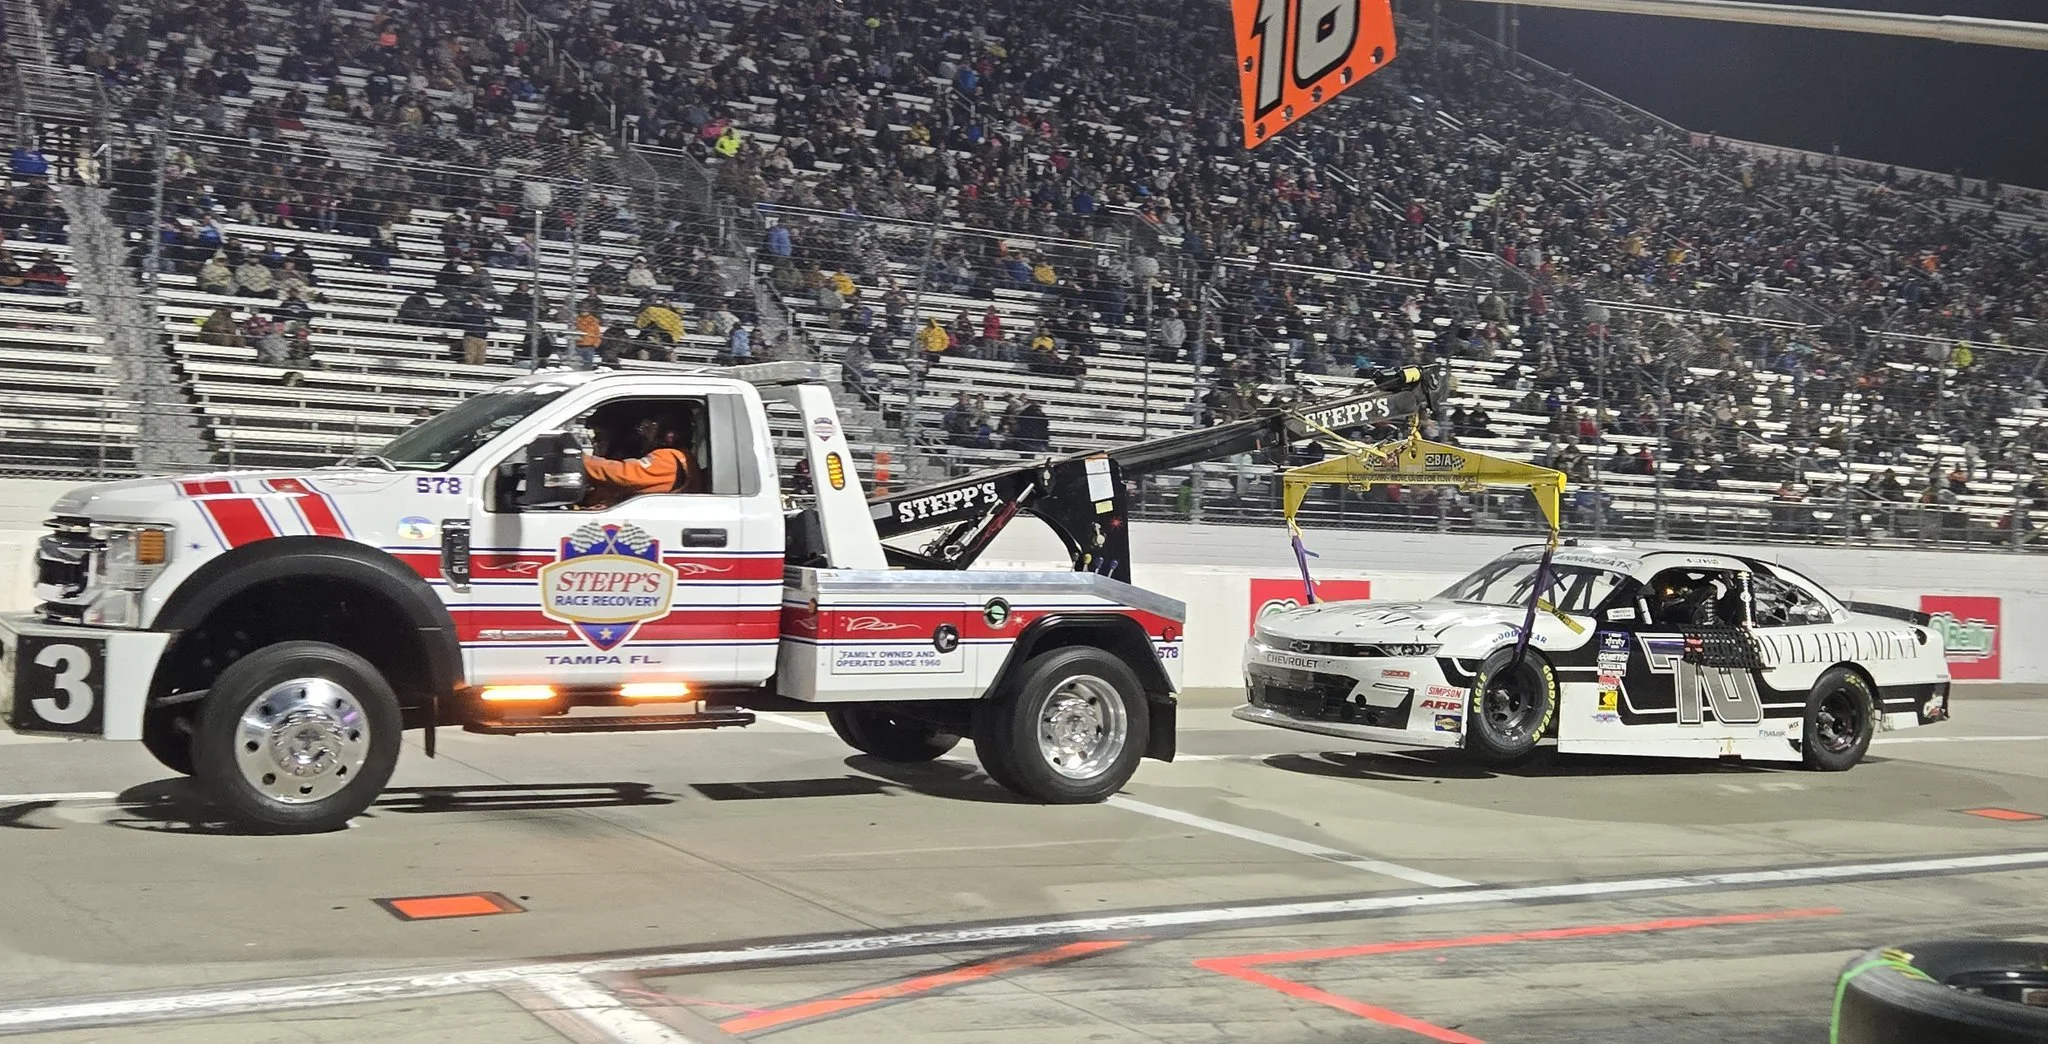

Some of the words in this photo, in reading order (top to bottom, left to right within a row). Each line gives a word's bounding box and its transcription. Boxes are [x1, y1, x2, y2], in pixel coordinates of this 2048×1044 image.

[1251, 0, 1360, 121] 16
[1304, 398, 1391, 433] STEPP'S
[416, 477, 462, 495] 578
[898, 481, 998, 524] STEPP'S
[556, 571, 661, 592] STEPP'S
[555, 595, 588, 606] RACE
[591, 596, 661, 607] RECOVERY
[840, 651, 876, 660] FAMILY
[879, 651, 914, 659] OWNED
[1157, 646, 1179, 658] 578
[1757, 628, 1919, 665] WILHELMINA
[546, 655, 622, 665] TAMPA
[630, 655, 662, 664] FL.
[836, 659, 886, 668] OPERATED
[888, 659, 917, 667] SINCE
[919, 659, 941, 667] 1960
[1266, 653, 1319, 669] CHEVROLET
[31, 644, 94, 724] 3
[1428, 686, 1463, 698] SIMPSON
[1473, 671, 1488, 713] EAGLE
[1420, 700, 1462, 711] ARP
[1532, 664, 1556, 742] GOODYEAR
